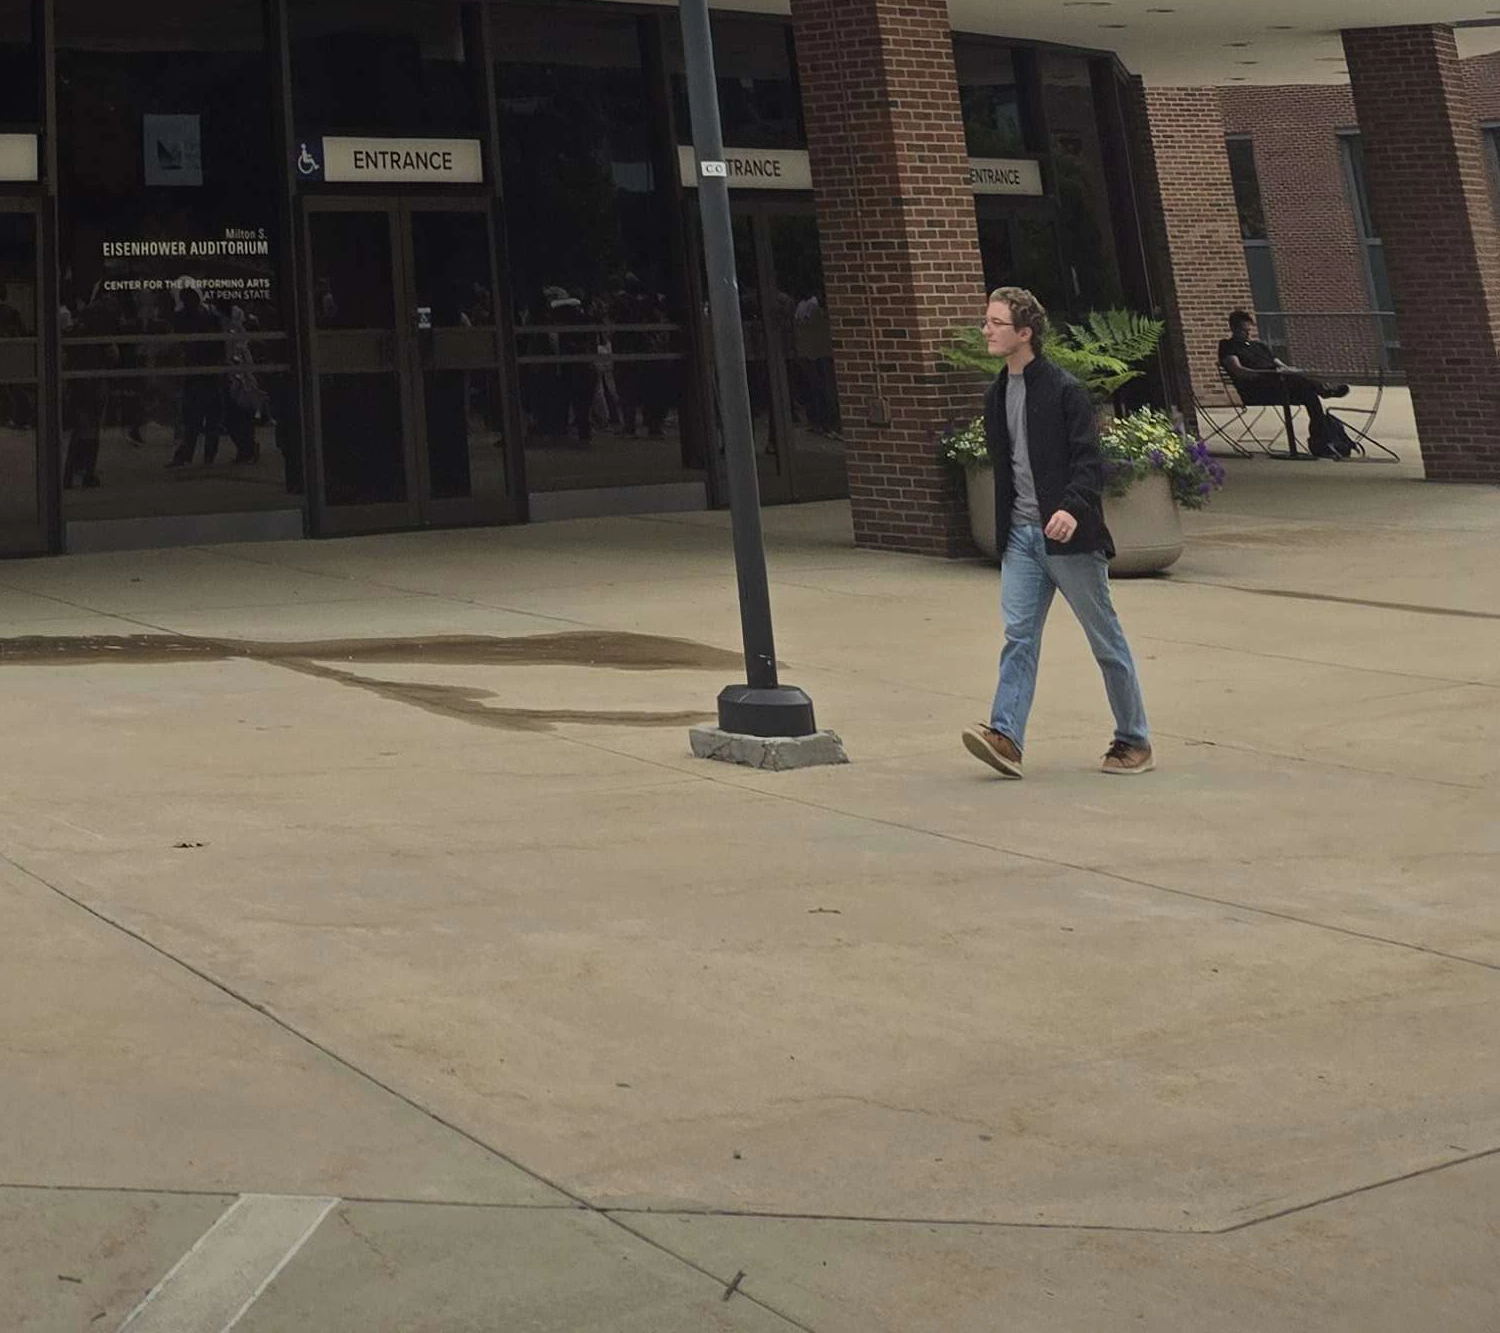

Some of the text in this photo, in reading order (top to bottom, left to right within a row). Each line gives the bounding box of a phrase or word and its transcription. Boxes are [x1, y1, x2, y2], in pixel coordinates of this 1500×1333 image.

[353, 149, 453, 172] ENTRANCE
[725, 159, 781, 177] TRANCE
[225, 228, 268, 240] Milton S.
[102, 240, 268, 257] EISENHOWER AUDITORIUM
[104, 278, 270, 291] CENTER FOR THE PERFORMING ARTS
[204, 290, 271, 300] AT PENN STATE
